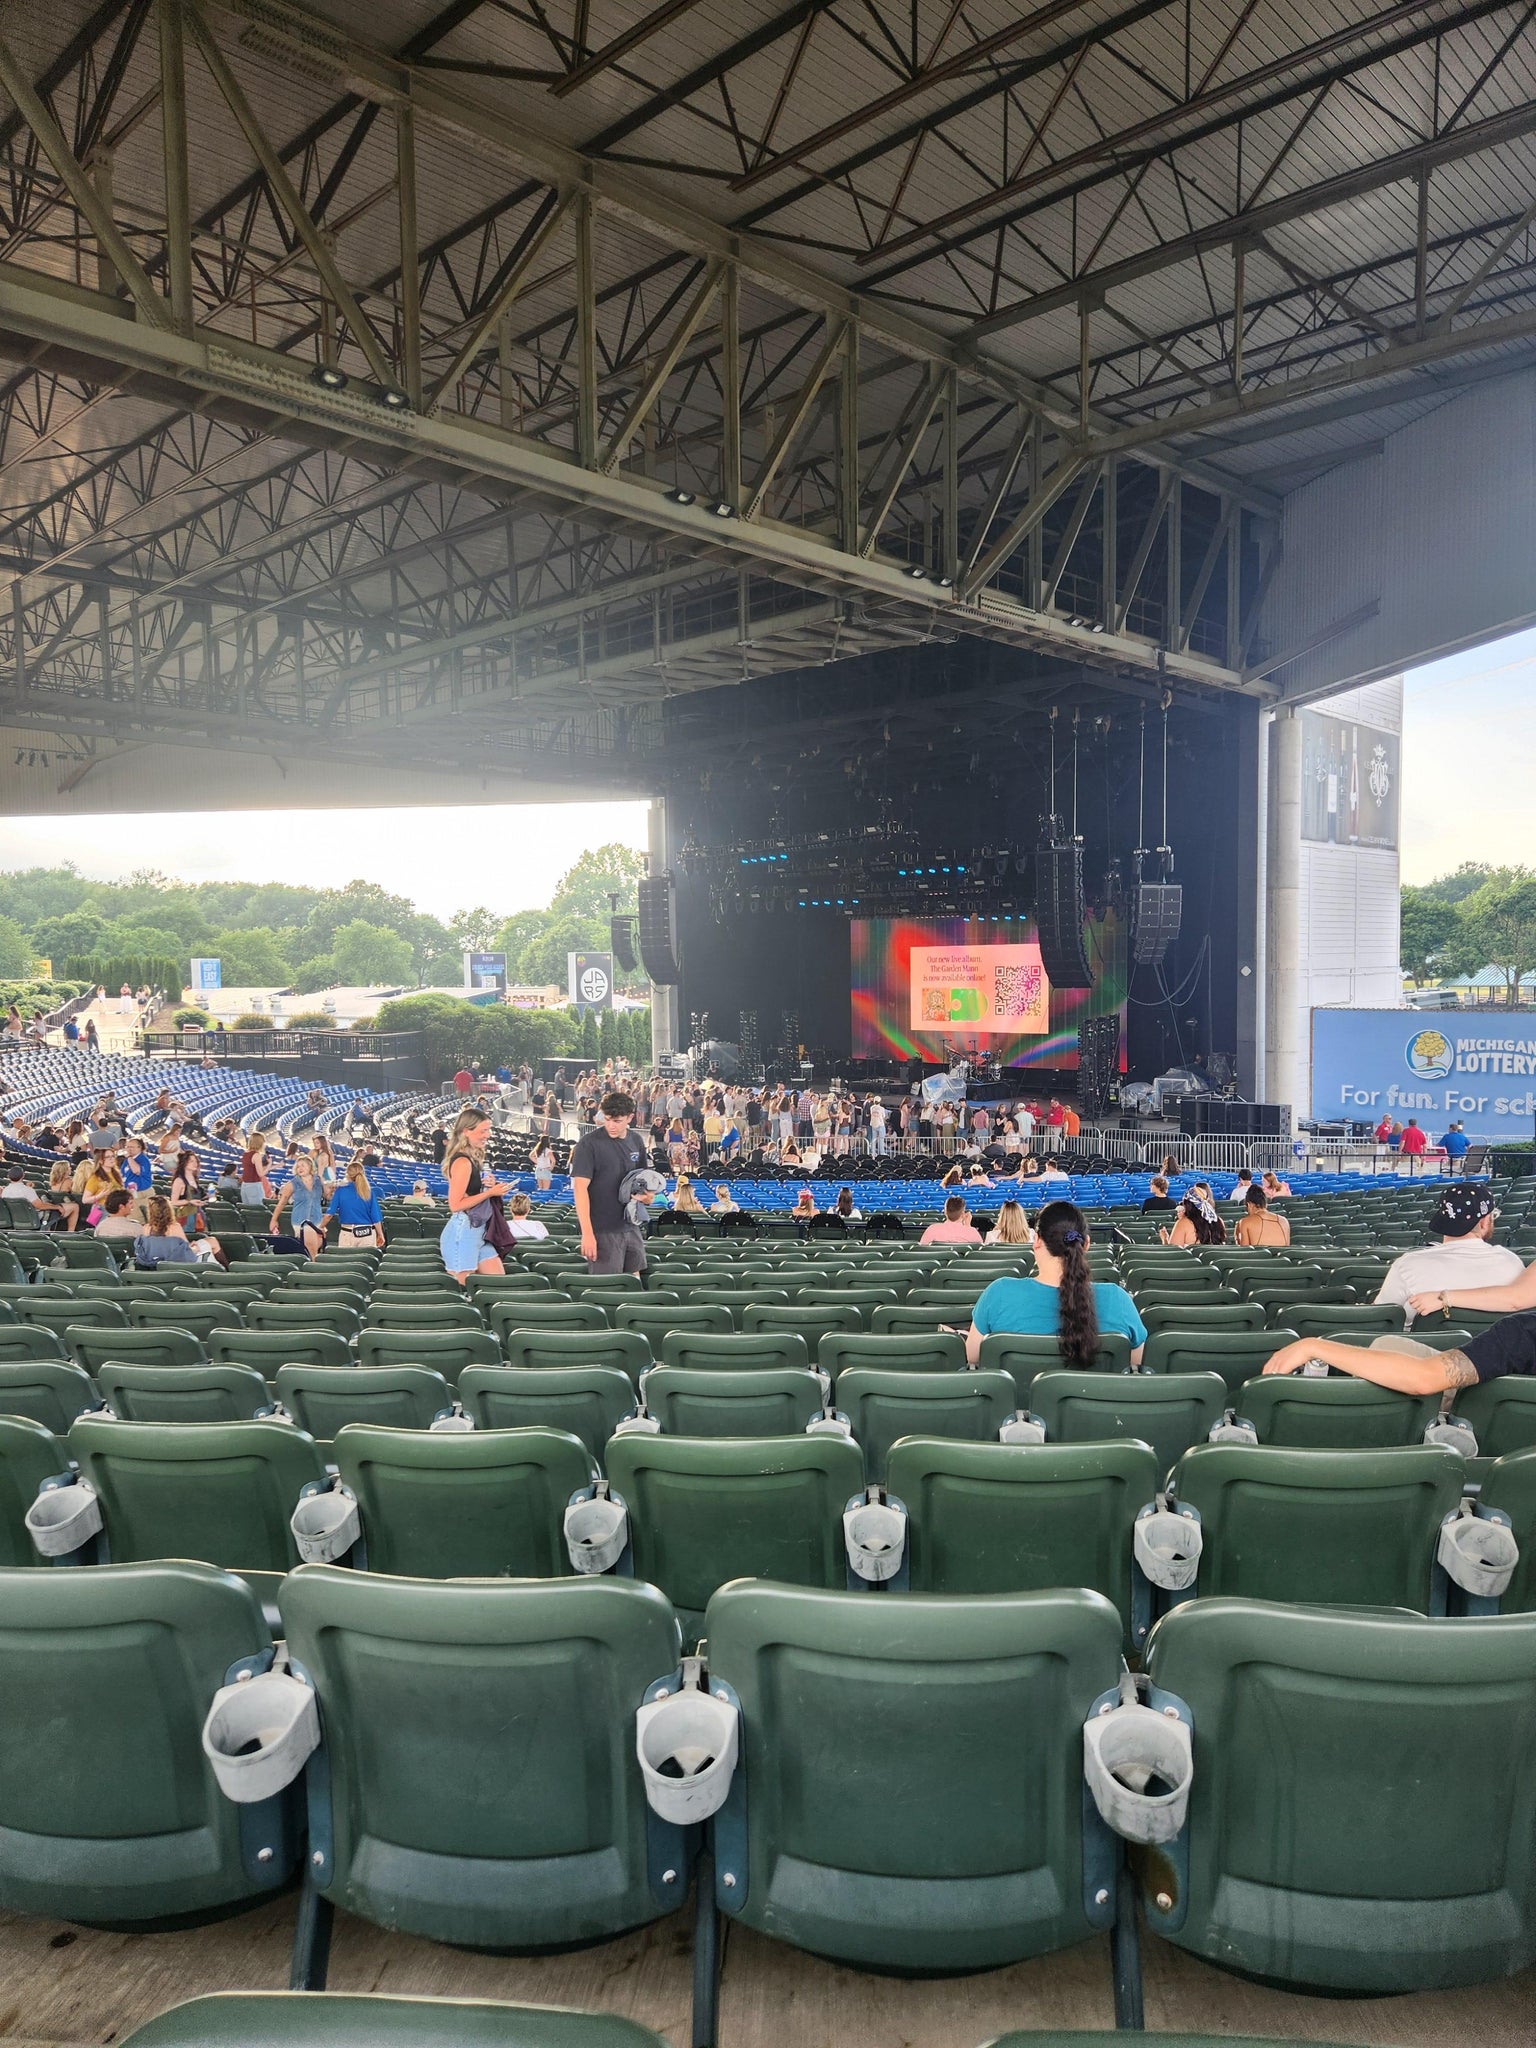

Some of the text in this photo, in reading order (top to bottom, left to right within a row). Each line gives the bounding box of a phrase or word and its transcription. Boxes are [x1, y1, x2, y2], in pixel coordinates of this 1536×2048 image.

[926, 955, 938, 963] Our
[930, 965, 942, 973] The
[1456, 1038, 1536, 1055] MICHIGAN
[1455, 1052, 1536, 1075] LOTTERY
[1340, 1084, 1380, 1106] For
[1386, 1084, 1439, 1110] fun.
[1445, 1090, 1488, 1113] For
